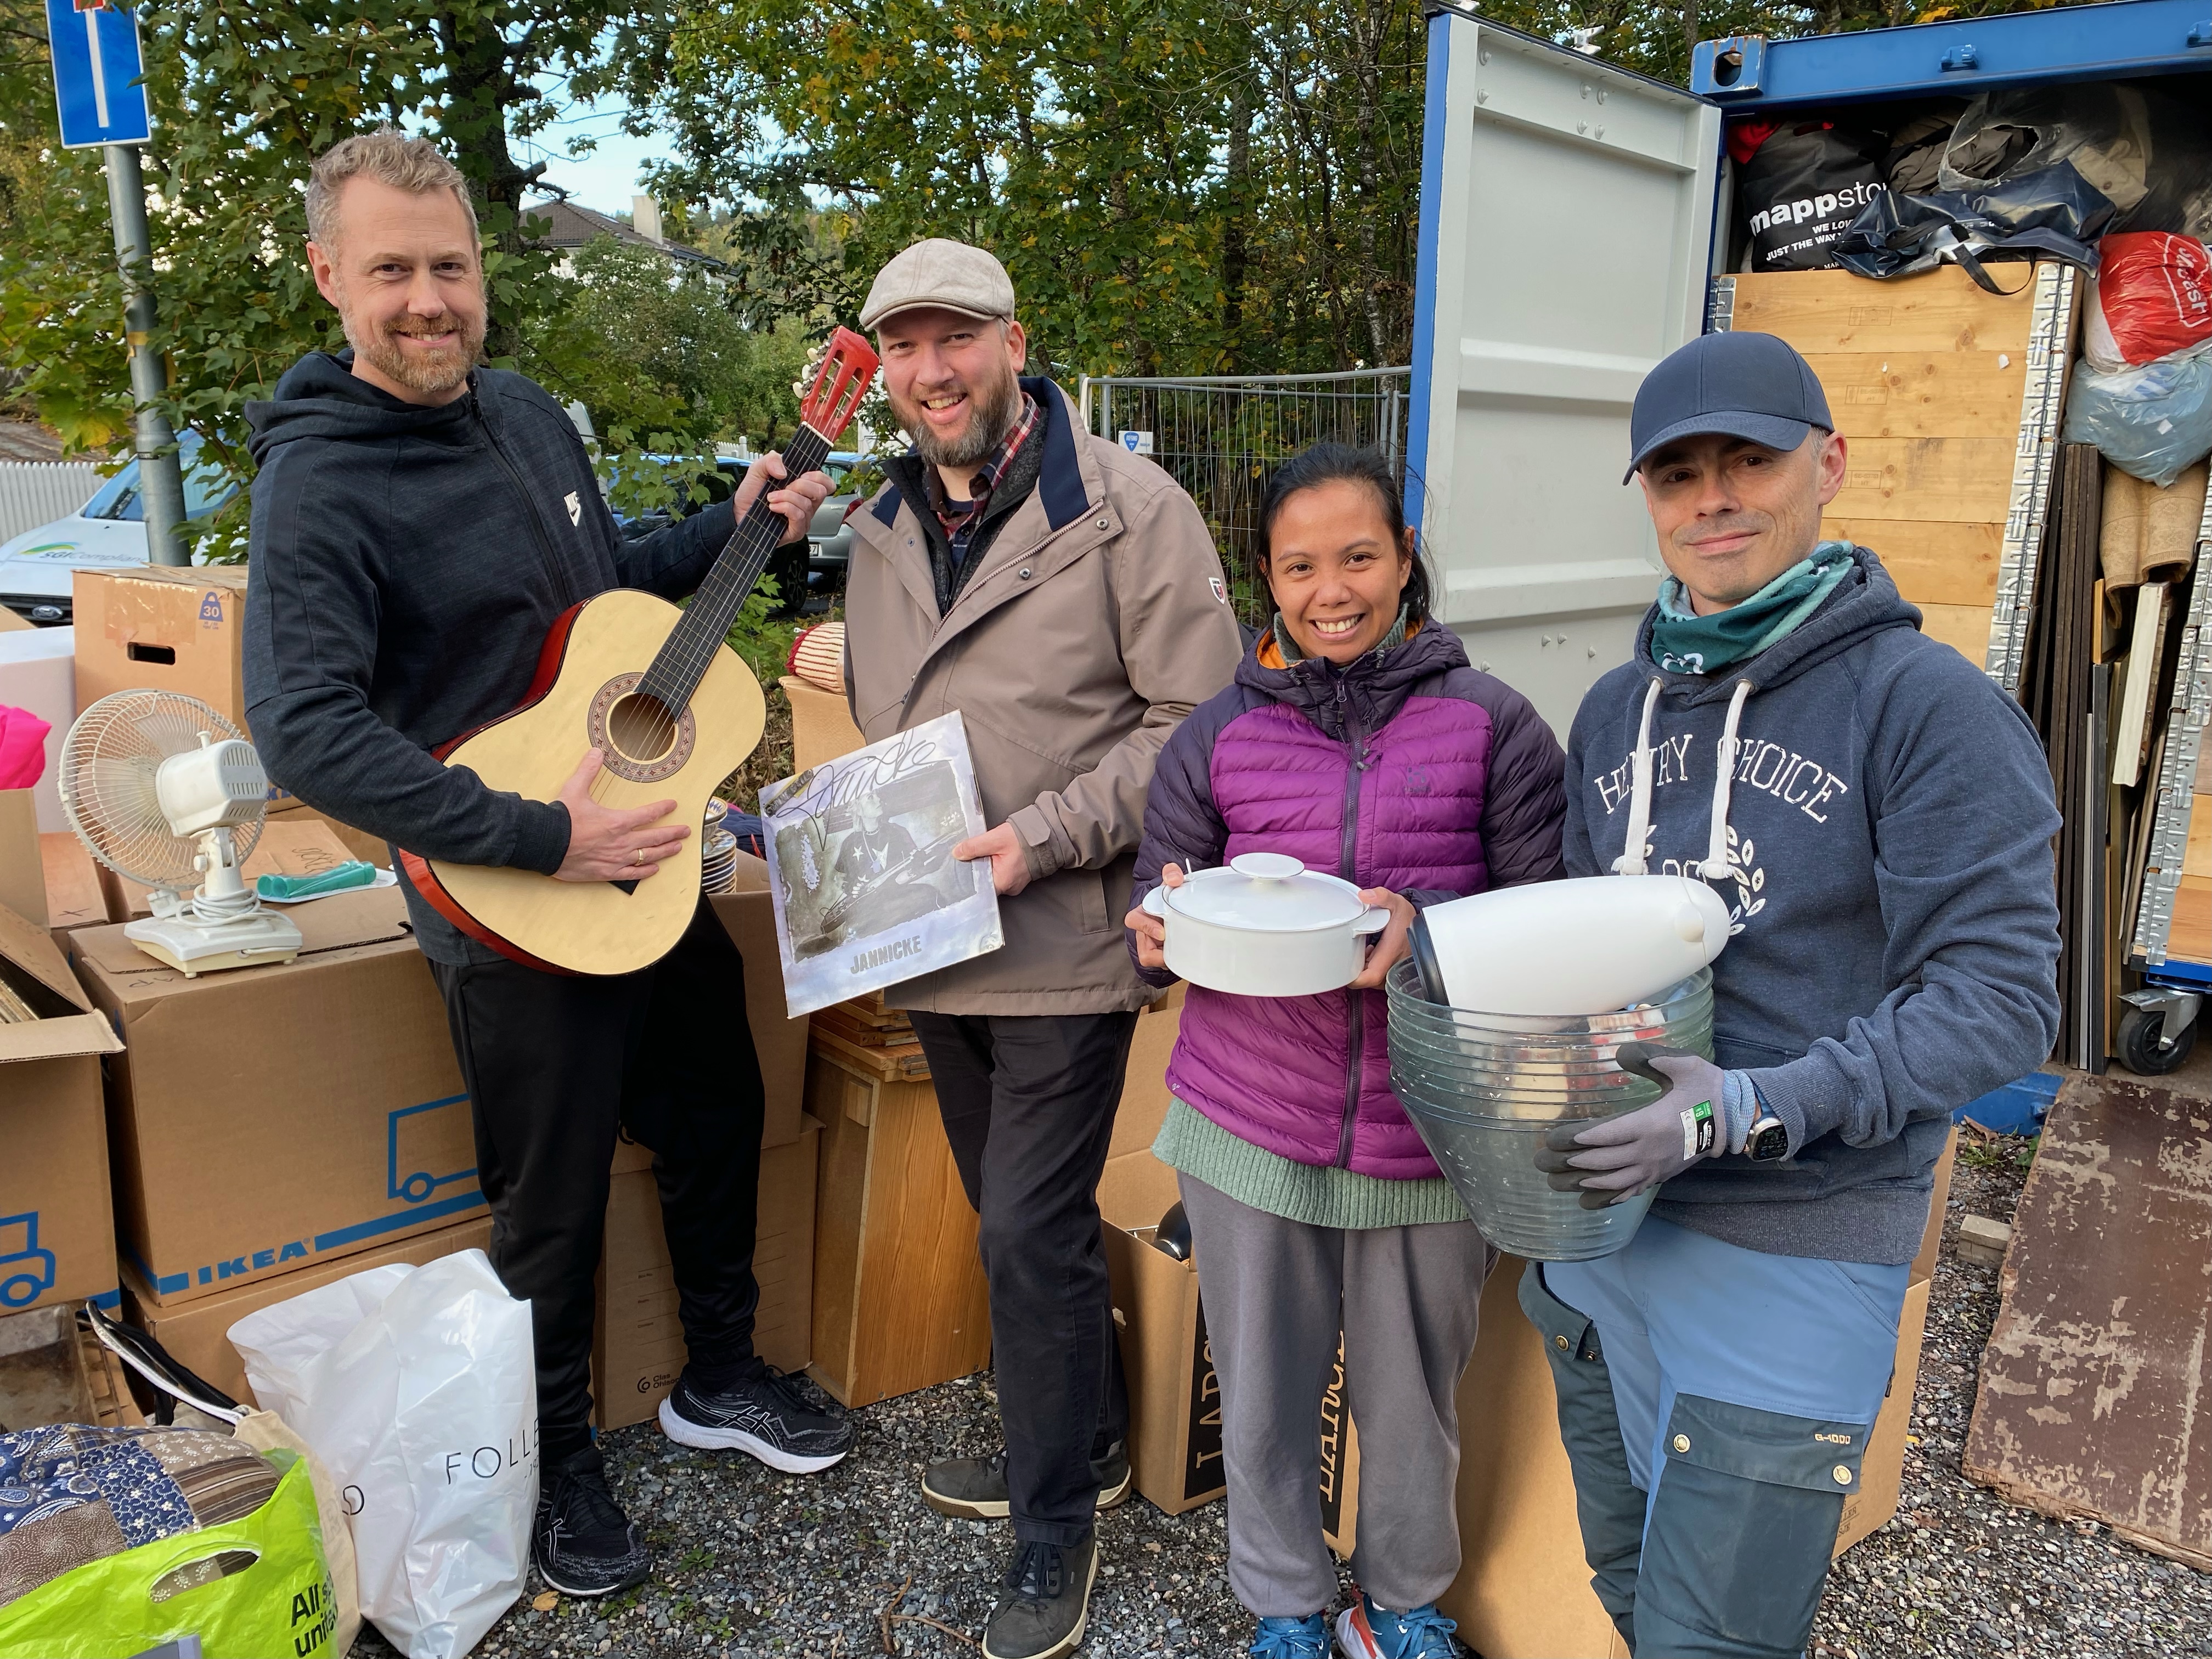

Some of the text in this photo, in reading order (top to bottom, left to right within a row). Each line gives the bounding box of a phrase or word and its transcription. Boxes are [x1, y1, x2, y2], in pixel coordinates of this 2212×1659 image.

[1812, 219, 1854, 234] WE LOV
[1766, 233, 1836, 261] JUST THE WAY
[204, 606, 219, 618] 30
[850, 935, 922, 974] JANNICKE
[198, 1240, 308, 1285] IKEA
[653, 1374, 670, 1382] Clas
[1814, 1434, 1851, 1444] G-1000
[291, 1583, 320, 1628] All
